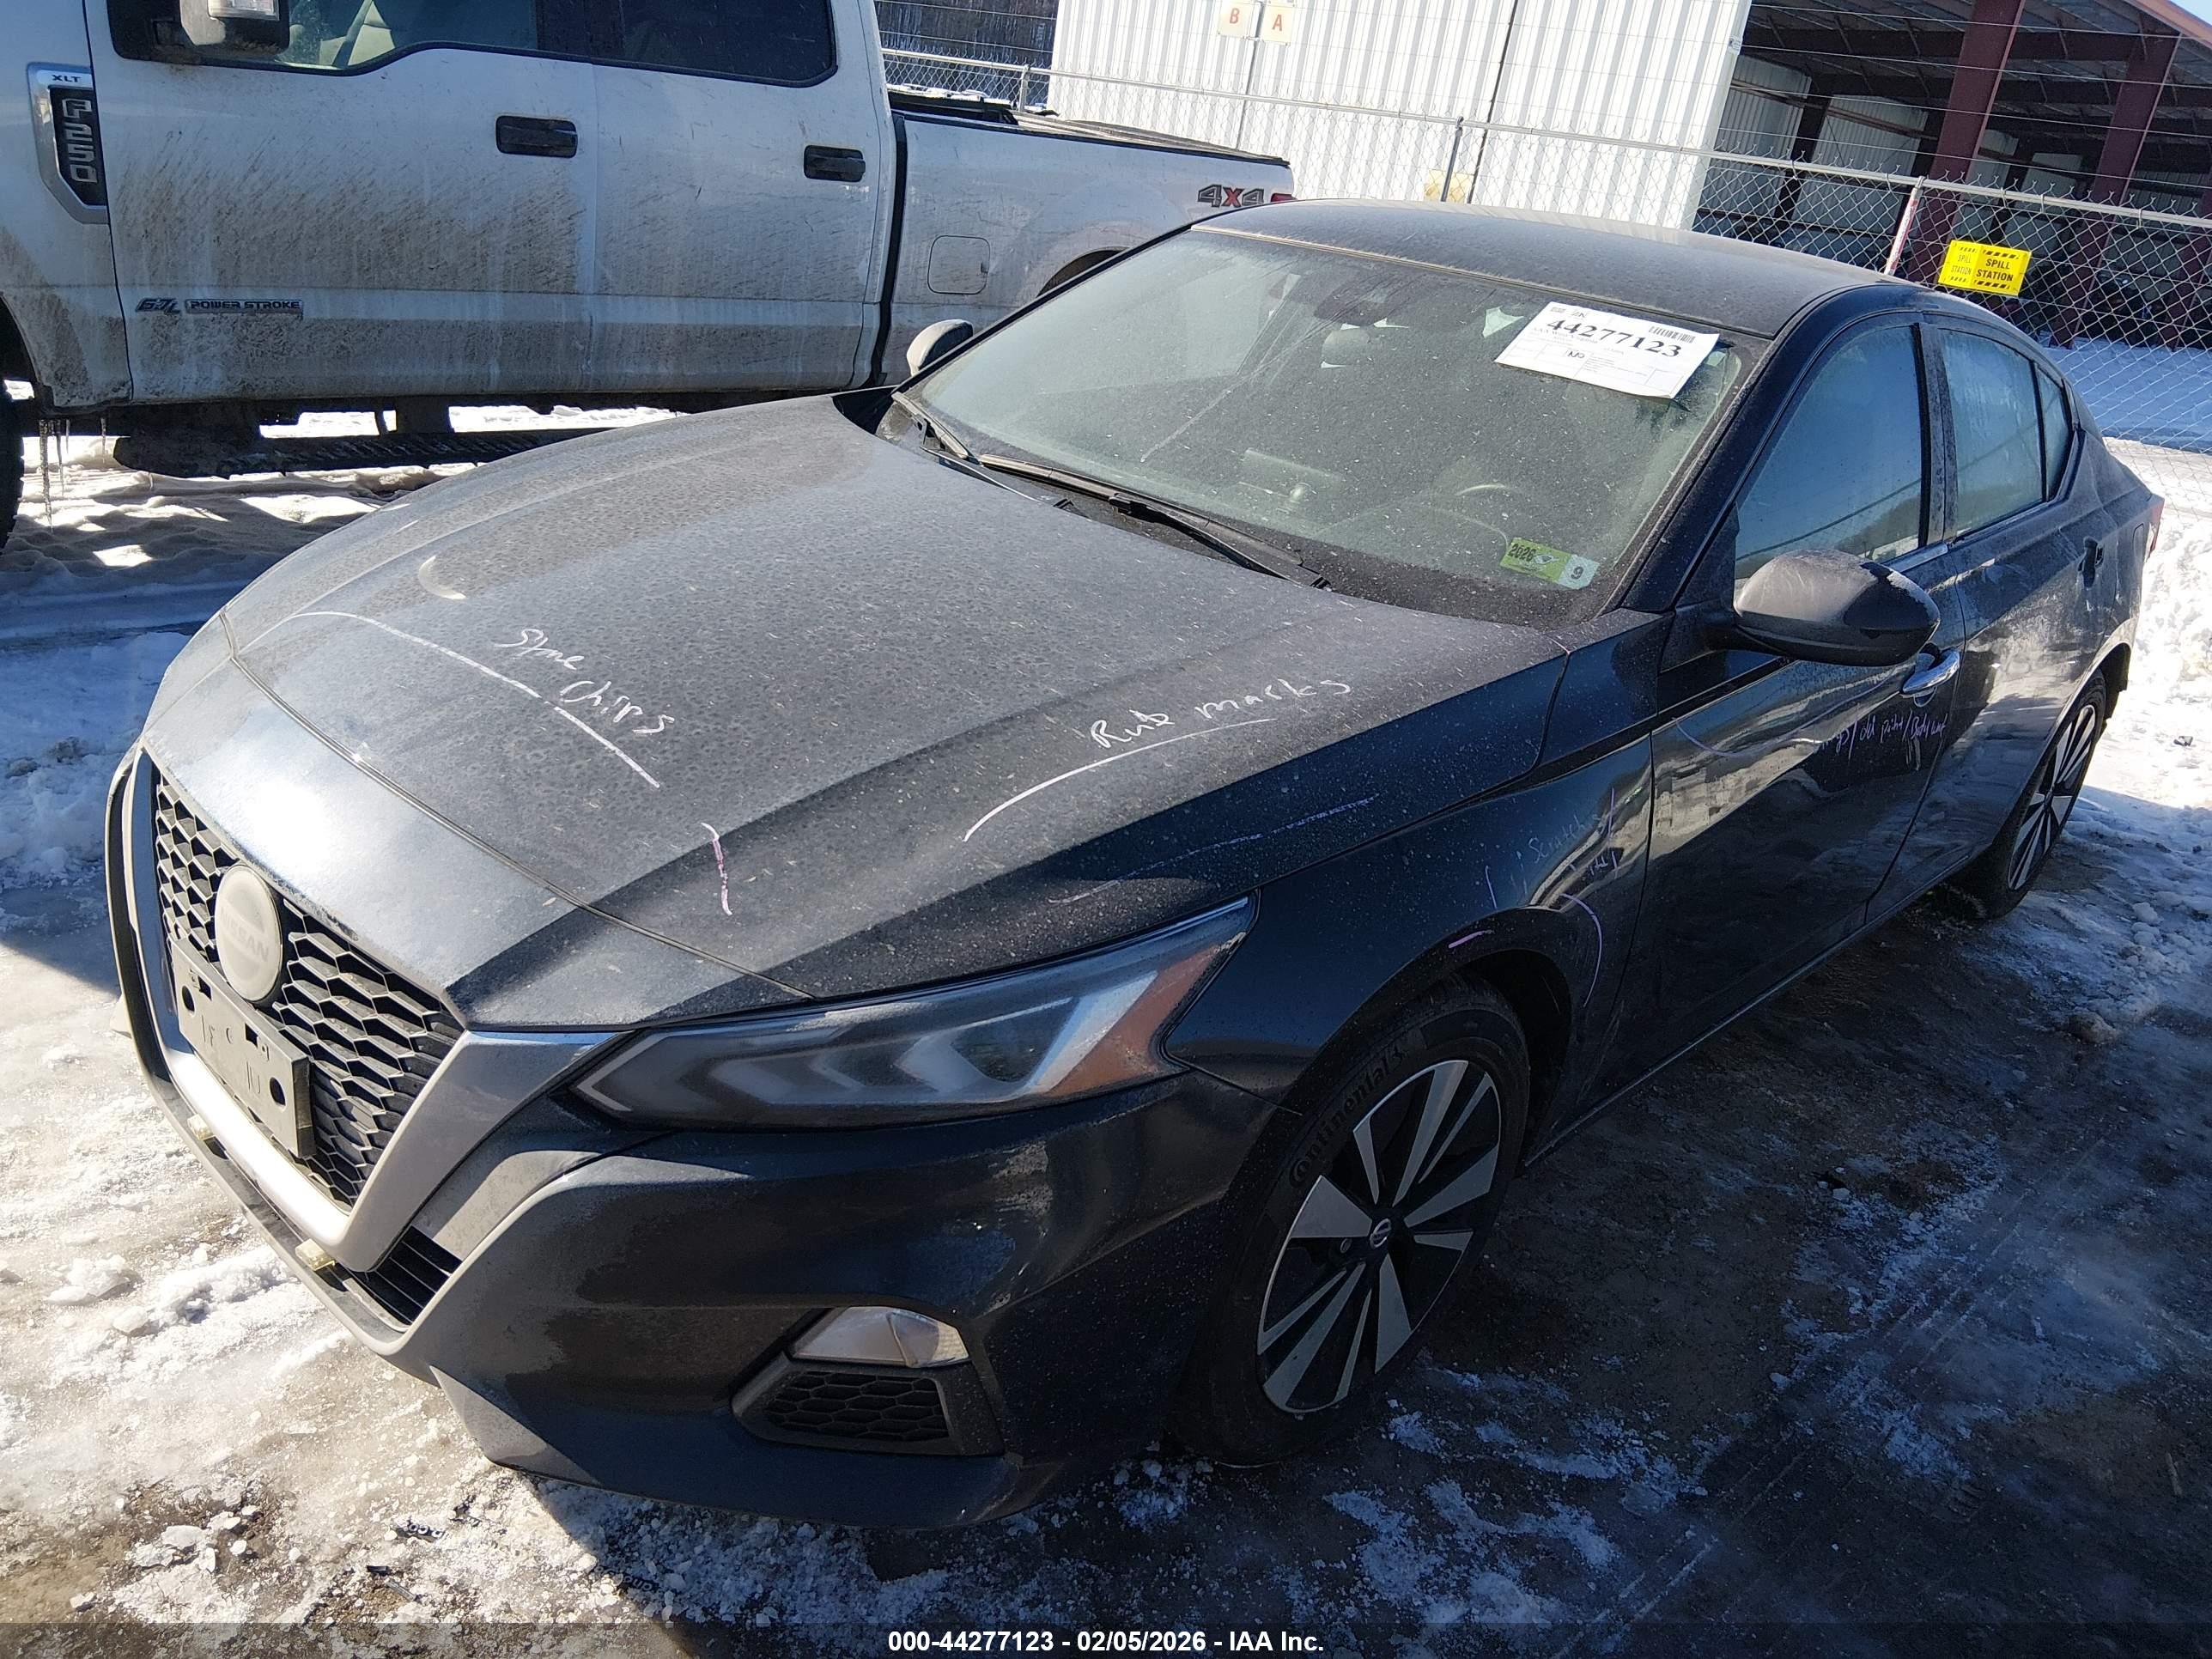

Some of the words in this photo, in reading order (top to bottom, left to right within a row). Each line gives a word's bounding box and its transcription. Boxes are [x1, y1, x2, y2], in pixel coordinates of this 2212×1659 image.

[1229, 8, 1240, 24] B
[1272, 14, 1283, 32] A
[52, 75, 81, 83] XLT
[1957, 254, 1972, 264] SPILL
[1985, 258, 2010, 270] SPILL
[1976, 269, 2014, 282] STATION
[191, 301, 241, 309] POWER
[244, 301, 301, 309] STROKE
[1547, 319, 1682, 357] 44277123
[1508, 543, 1536, 562] 2026
[1571, 567, 1584, 580] 9
[1091, 709, 1175, 748] Rub
[221, 906, 269, 963] NISSAN
